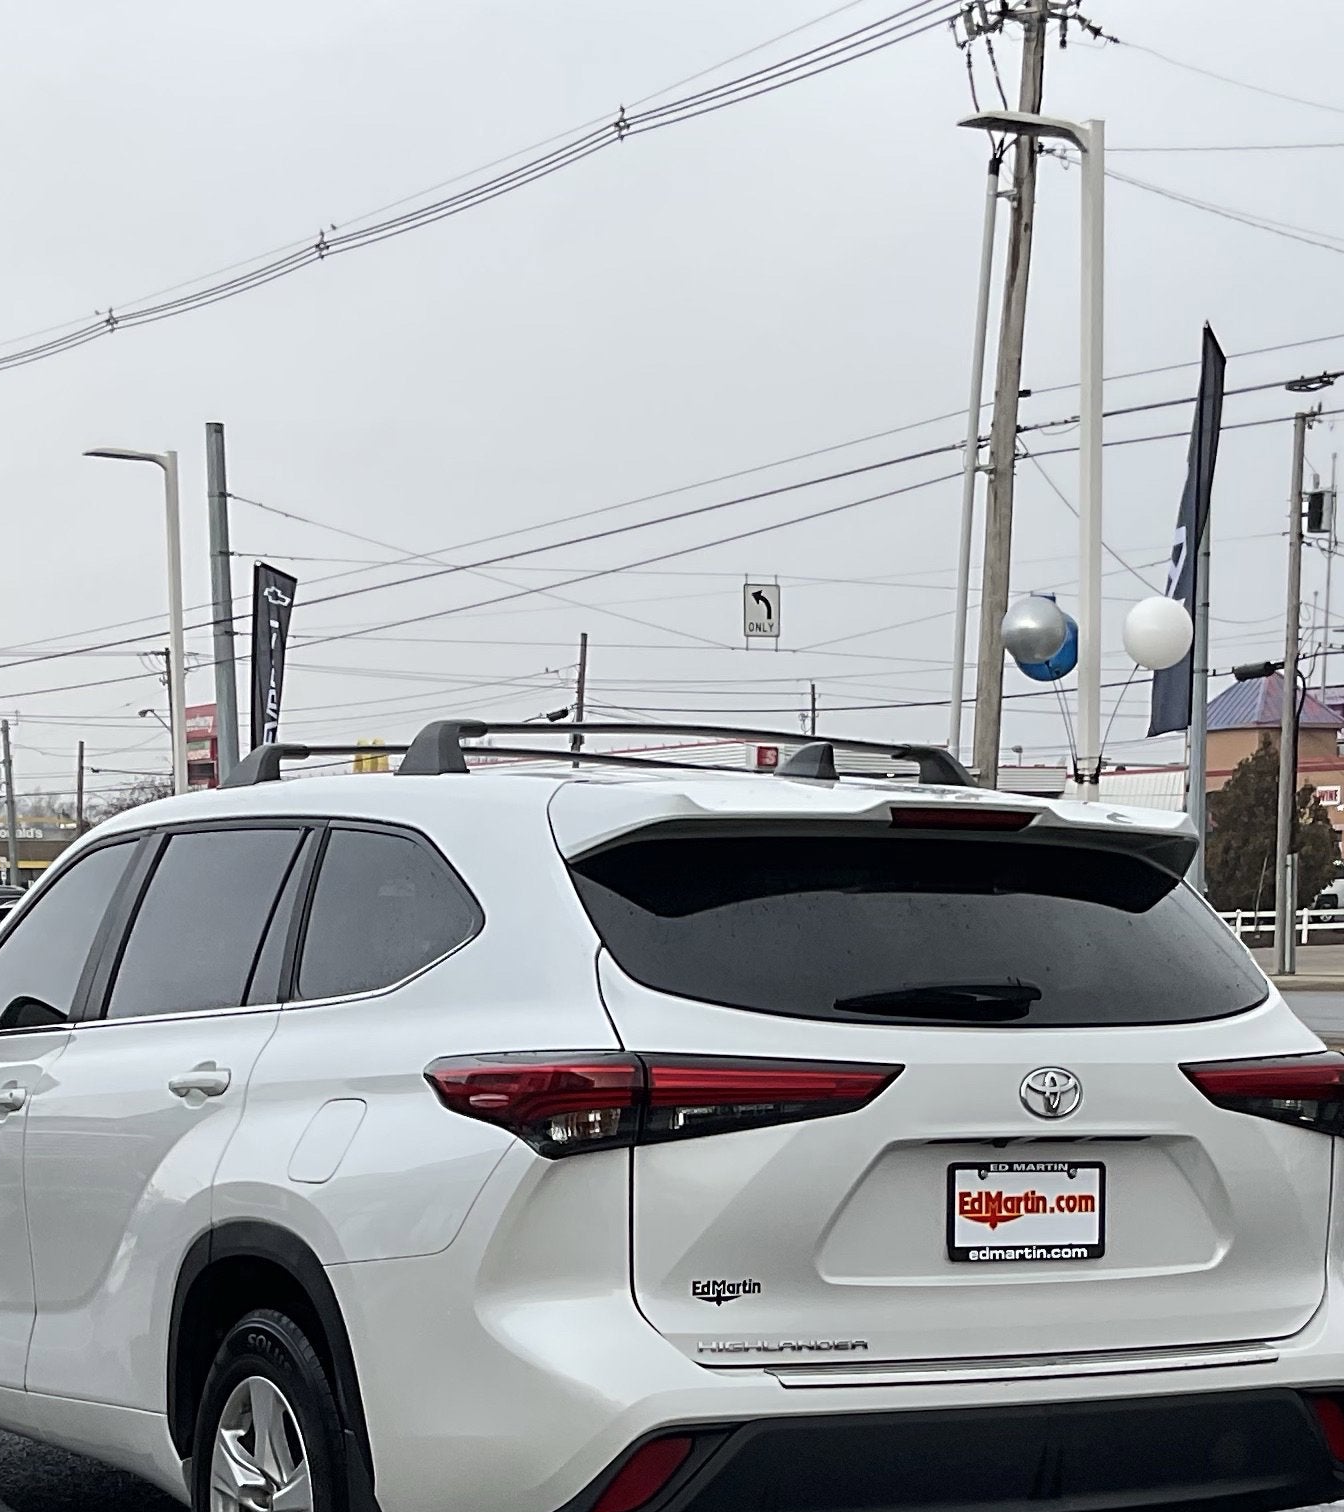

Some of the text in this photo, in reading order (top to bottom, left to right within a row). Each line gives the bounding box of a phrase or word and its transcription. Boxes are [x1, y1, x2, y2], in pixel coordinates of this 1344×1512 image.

[748, 621, 775, 633] ONLY
[990, 1162, 1069, 1172] ED MARTIN
[958, 1190, 1096, 1218] EdMartin.com
[968, 1245, 1089, 1262] edmartin.com
[697, 1340, 869, 1353] HIGHLANDER
